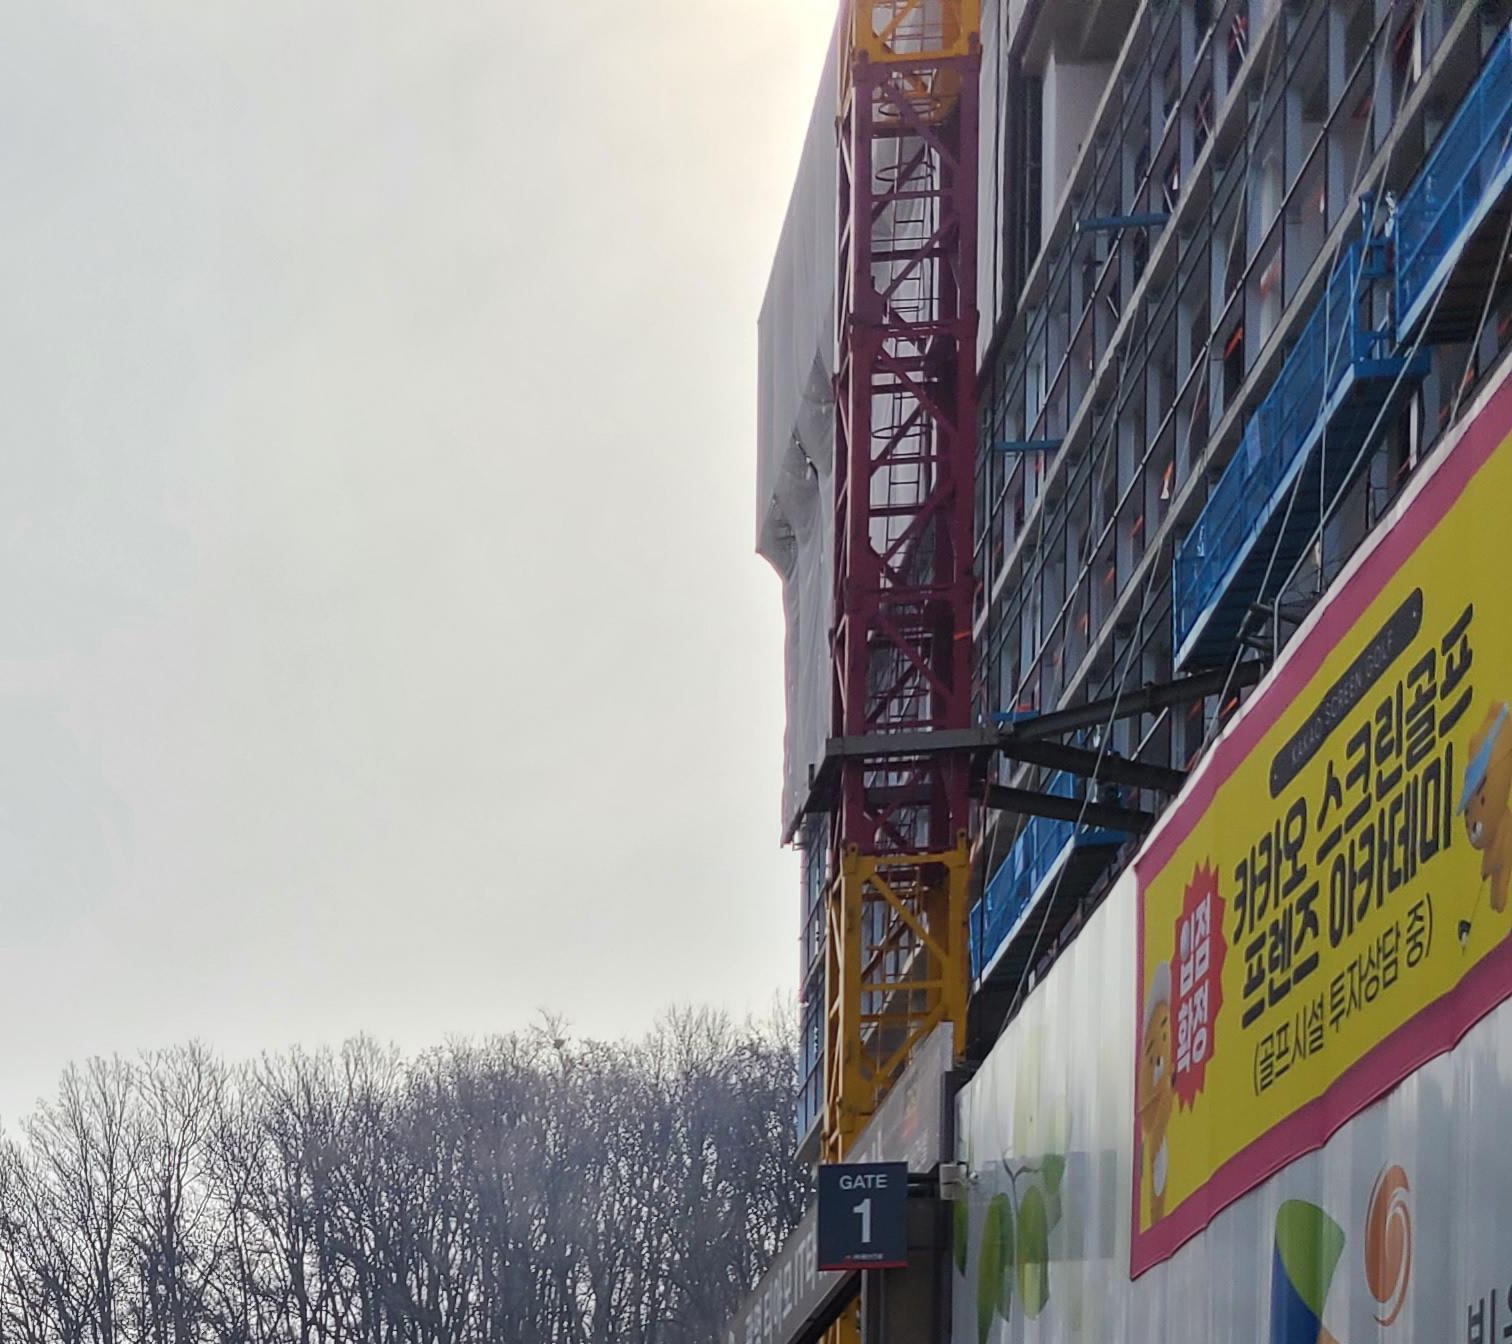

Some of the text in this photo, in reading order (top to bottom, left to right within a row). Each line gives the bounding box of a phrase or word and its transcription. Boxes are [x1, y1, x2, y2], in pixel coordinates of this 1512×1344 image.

[1233, 603, 1473, 945] 카카오 스크린골프
[1242, 742, 1452, 1029] 프렌즈 아카데미
[1180, 892, 1211, 998] 입점
[1253, 892, 1433, 1096] (골프시설 투자상담 중)
[1177, 979, 1209, 1073] 확정
[839, 1173, 888, 1190] GATE
[852, 1198, 872, 1243] 1
